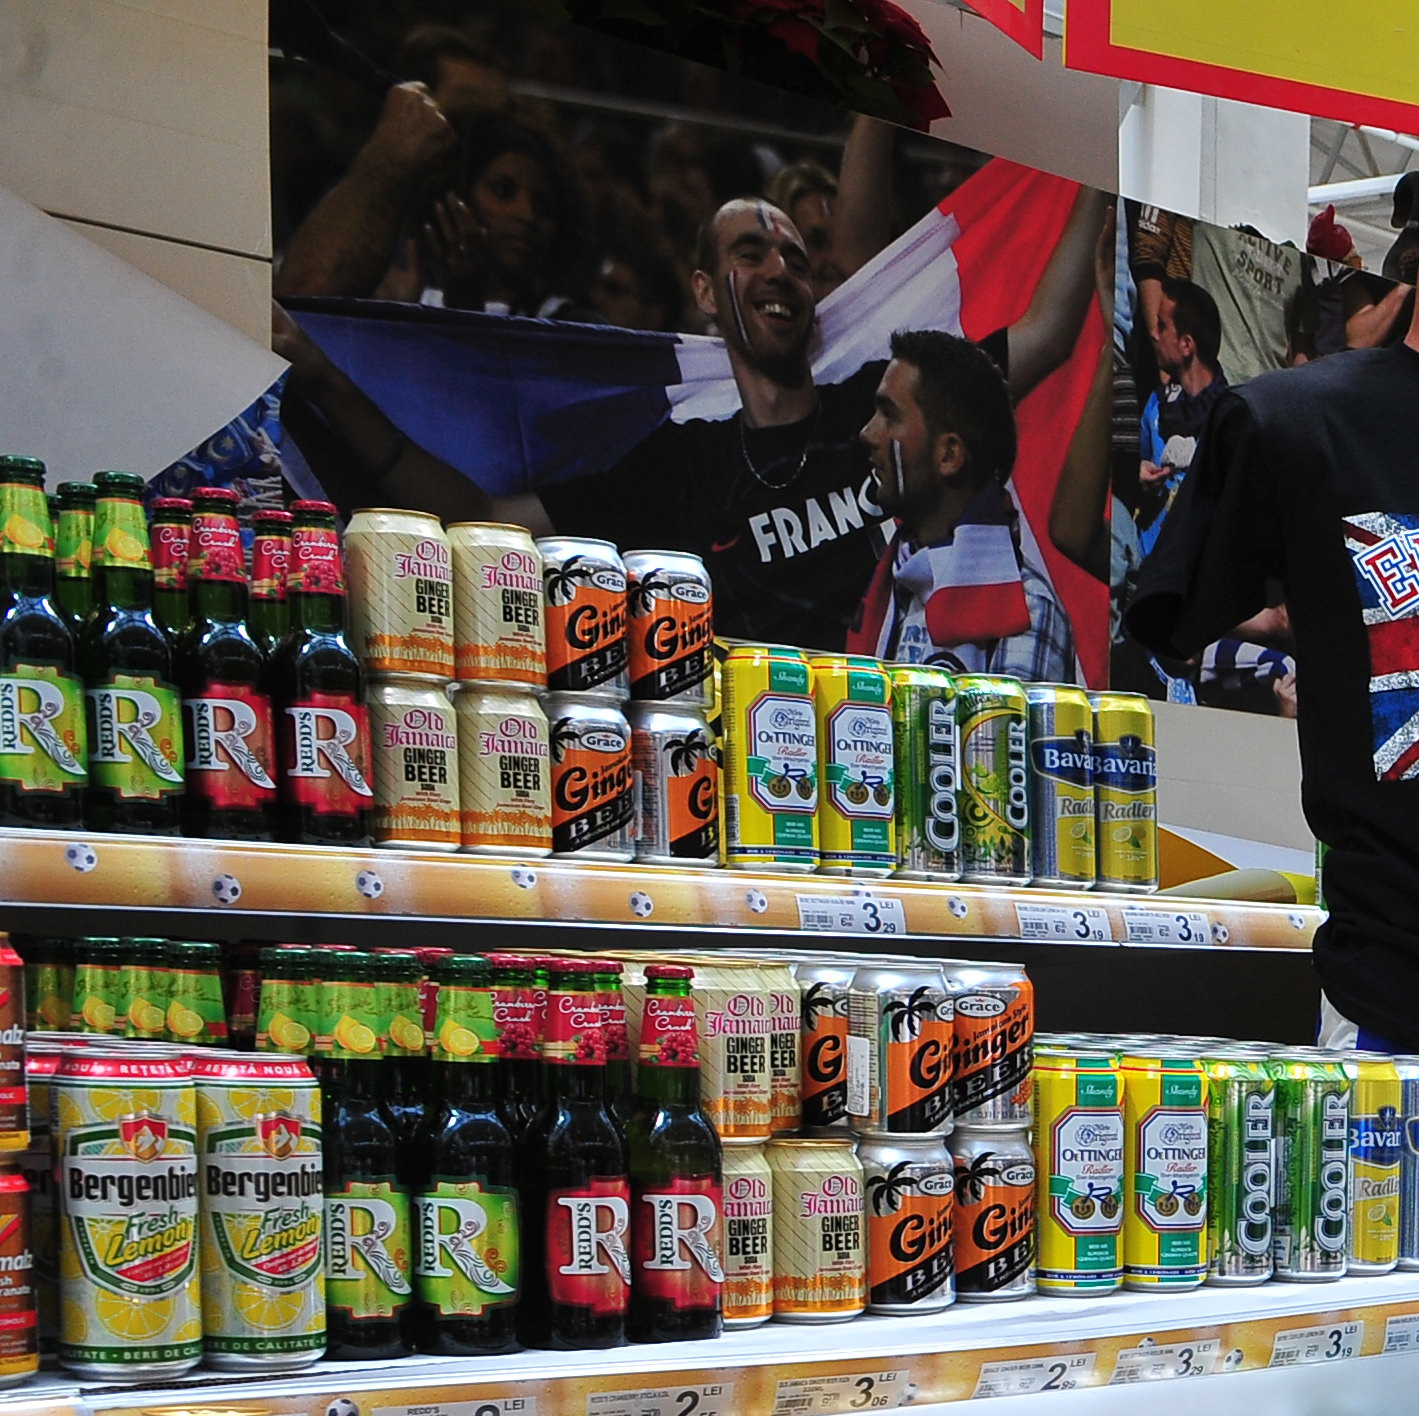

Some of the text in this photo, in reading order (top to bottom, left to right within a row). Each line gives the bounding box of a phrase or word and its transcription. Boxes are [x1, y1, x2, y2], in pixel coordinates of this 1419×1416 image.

[1236, 250, 1285, 296] SPORT
[416, 540, 448, 561] Old
[501, 552, 536, 573] Old
[415, 579, 450, 599] GINGER
[596, 573, 625, 589] Grace
[675, 587, 706, 601] Grace
[416, 595, 450, 617] BEER
[501, 589, 538, 610] GINGER
[502, 605, 539, 627] BEER
[100, 692, 115, 760] REDD'S
[198, 701, 212, 768] REDD'S
[403, 709, 444, 732] Old
[300, 710, 314, 774] REDD'S
[383, 723, 455, 750] Jamaica
[586, 735, 622, 750] Grace
[404, 747, 446, 766] GINGER
[404, 763, 448, 784] BEER
[1006, 721, 1027, 830] COOLER
[1103, 802, 1154, 821] Radler
[863, 902, 896, 934] 3 29
[1075, 911, 1103, 941] 3 19
[957, 997, 1003, 1014] Grace
[726, 1036, 765, 1054] GINGER
[727, 1052, 766, 1074] BEER
[125, 1206, 180, 1238] Fresh
[261, 1201, 310, 1234] Fresh
[106, 1220, 189, 1266] Lemon
[242, 1216, 318, 1261] Lemon
[419, 1201, 434, 1274] REDD'S
[579, 1202, 592, 1271] REDD'S
[659, 1200, 673, 1266] REDD'S
[1326, 1329, 1353, 1359] 3 19
[1042, 1362, 1069, 1391] 2
[1061, 1378, 1076, 1390] 99
[849, 1376, 874, 1409] 3
[870, 1394, 888, 1407] 06
